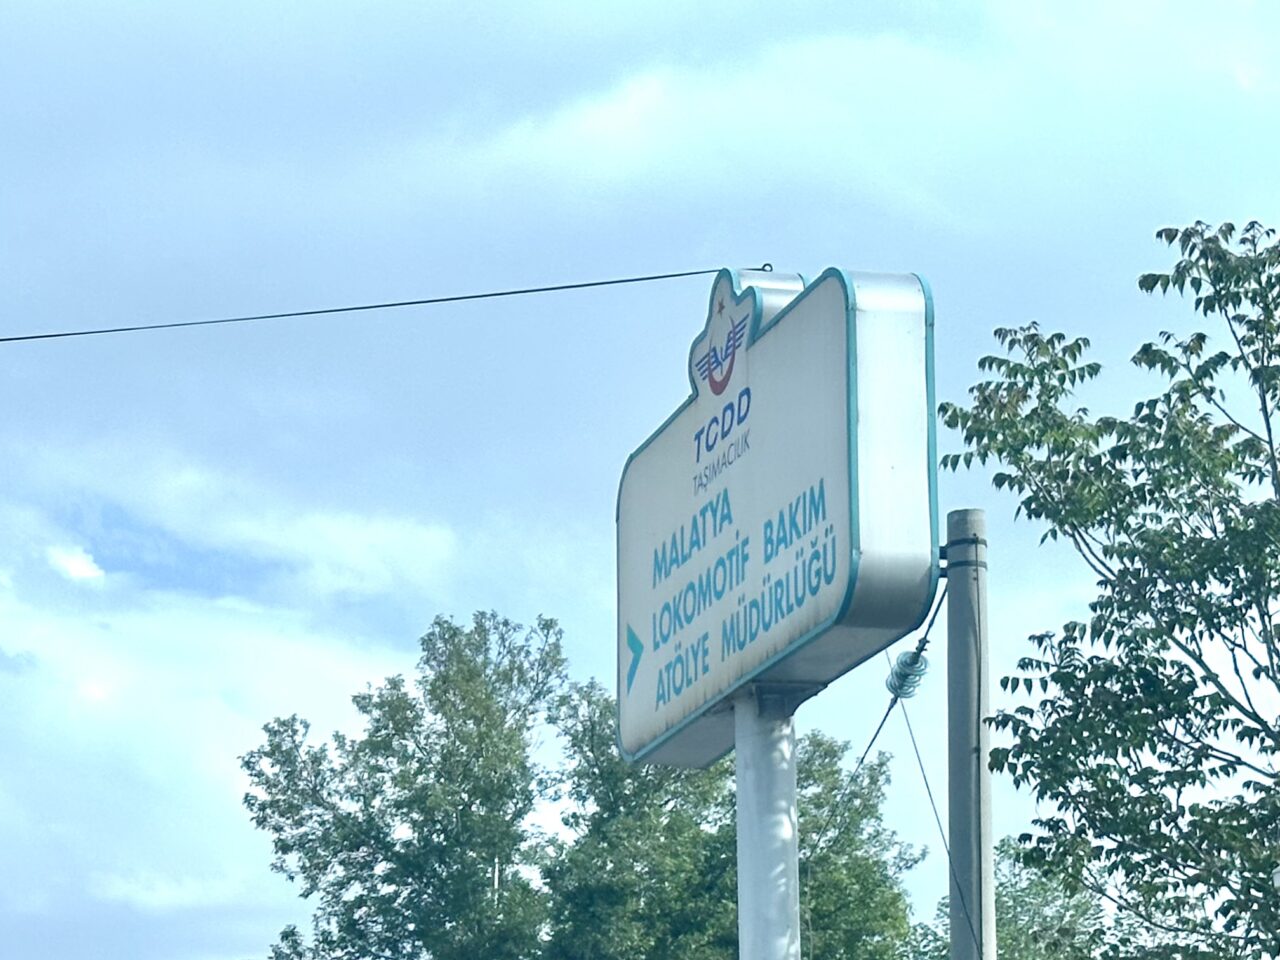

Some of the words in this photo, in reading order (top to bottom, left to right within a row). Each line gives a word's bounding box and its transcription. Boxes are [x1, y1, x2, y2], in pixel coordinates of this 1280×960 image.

[693, 428, 750, 496] TAŞIMACILIK
[694, 387, 751, 463] TCDD
[652, 529, 750, 652] LOKOMOTİF
[763, 477, 826, 565] BAKIM
[653, 487, 733, 589] MALATYA
[655, 631, 709, 712] ATÖLYE
[721, 524, 837, 662] MÜDÜRLÜĞÜ
